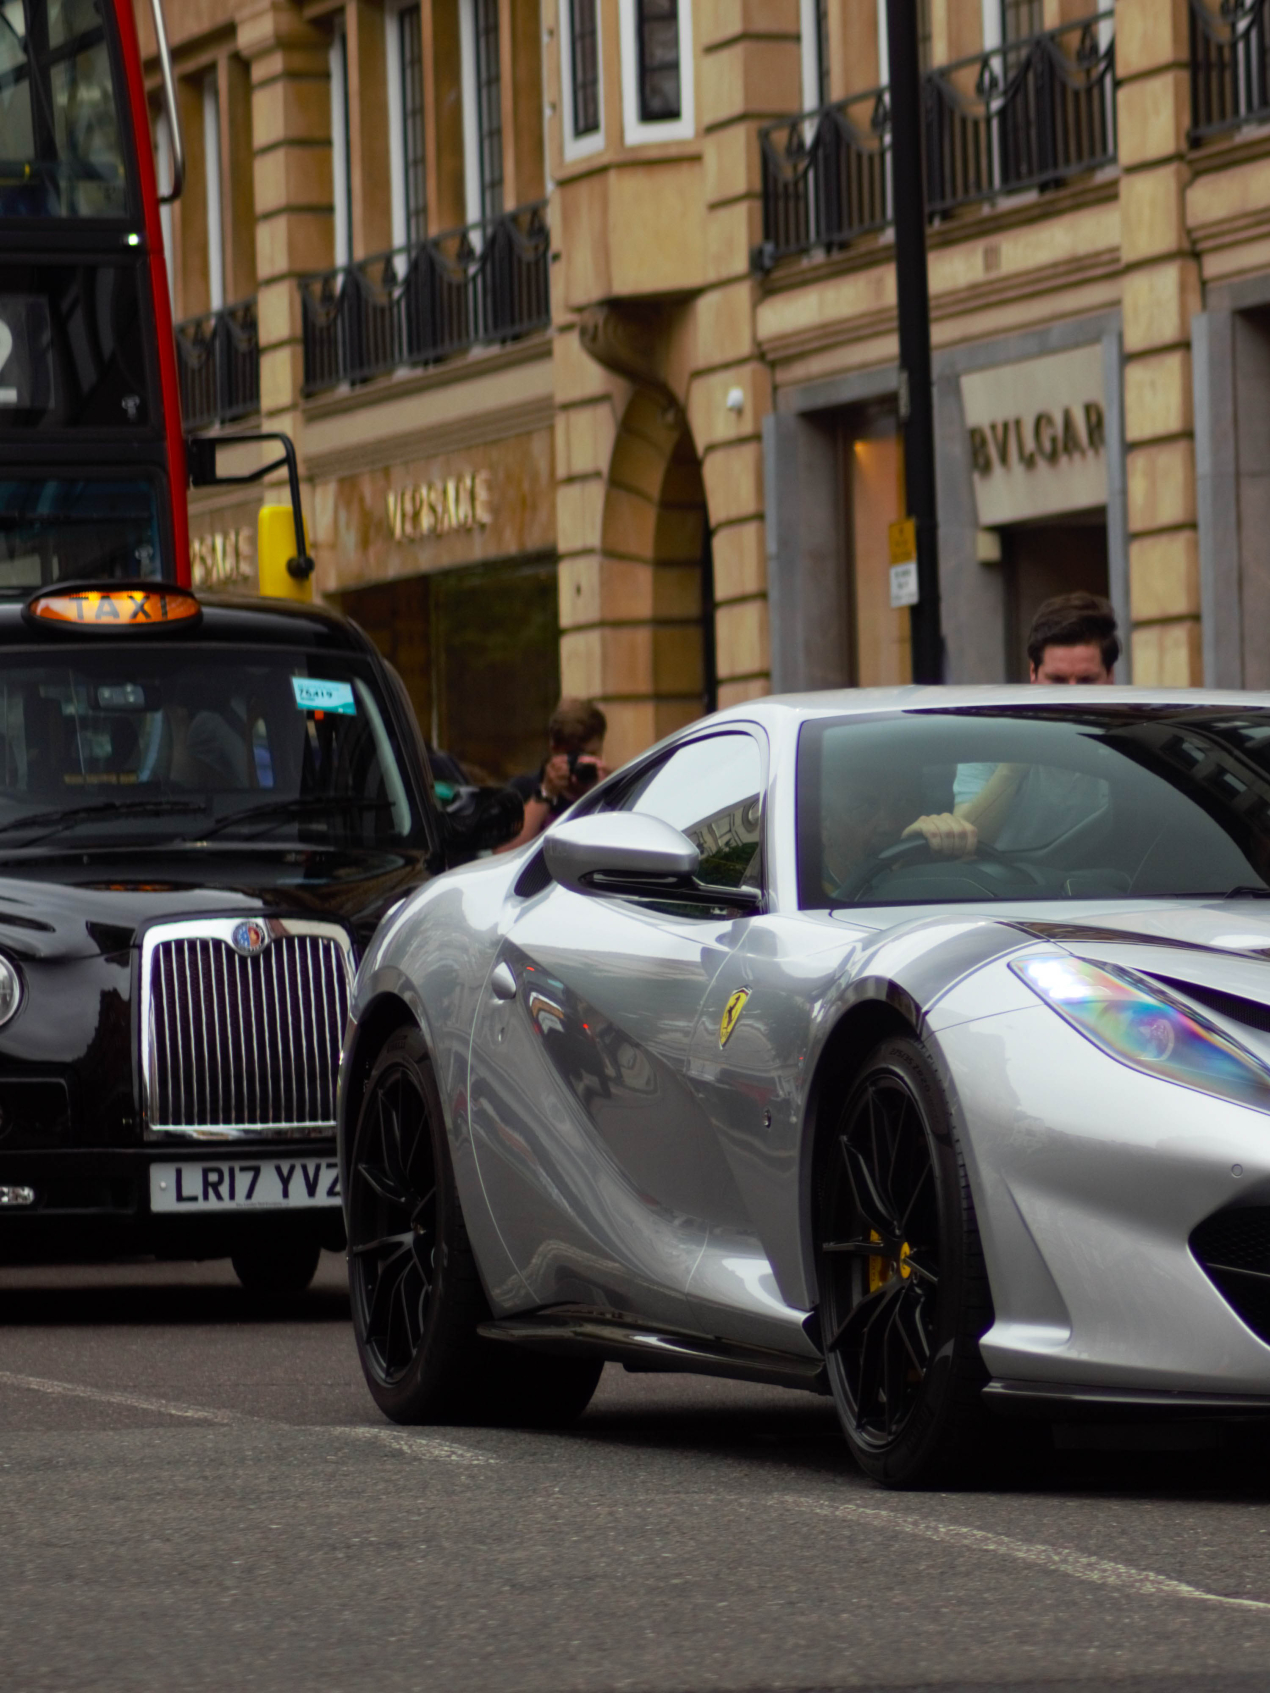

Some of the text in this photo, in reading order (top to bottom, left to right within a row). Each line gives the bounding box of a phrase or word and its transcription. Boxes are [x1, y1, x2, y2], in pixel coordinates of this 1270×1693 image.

[387, 469, 492, 540] VERSACE
[68, 594, 169, 620] TAXI
[175, 1164, 262, 1203] LR17
